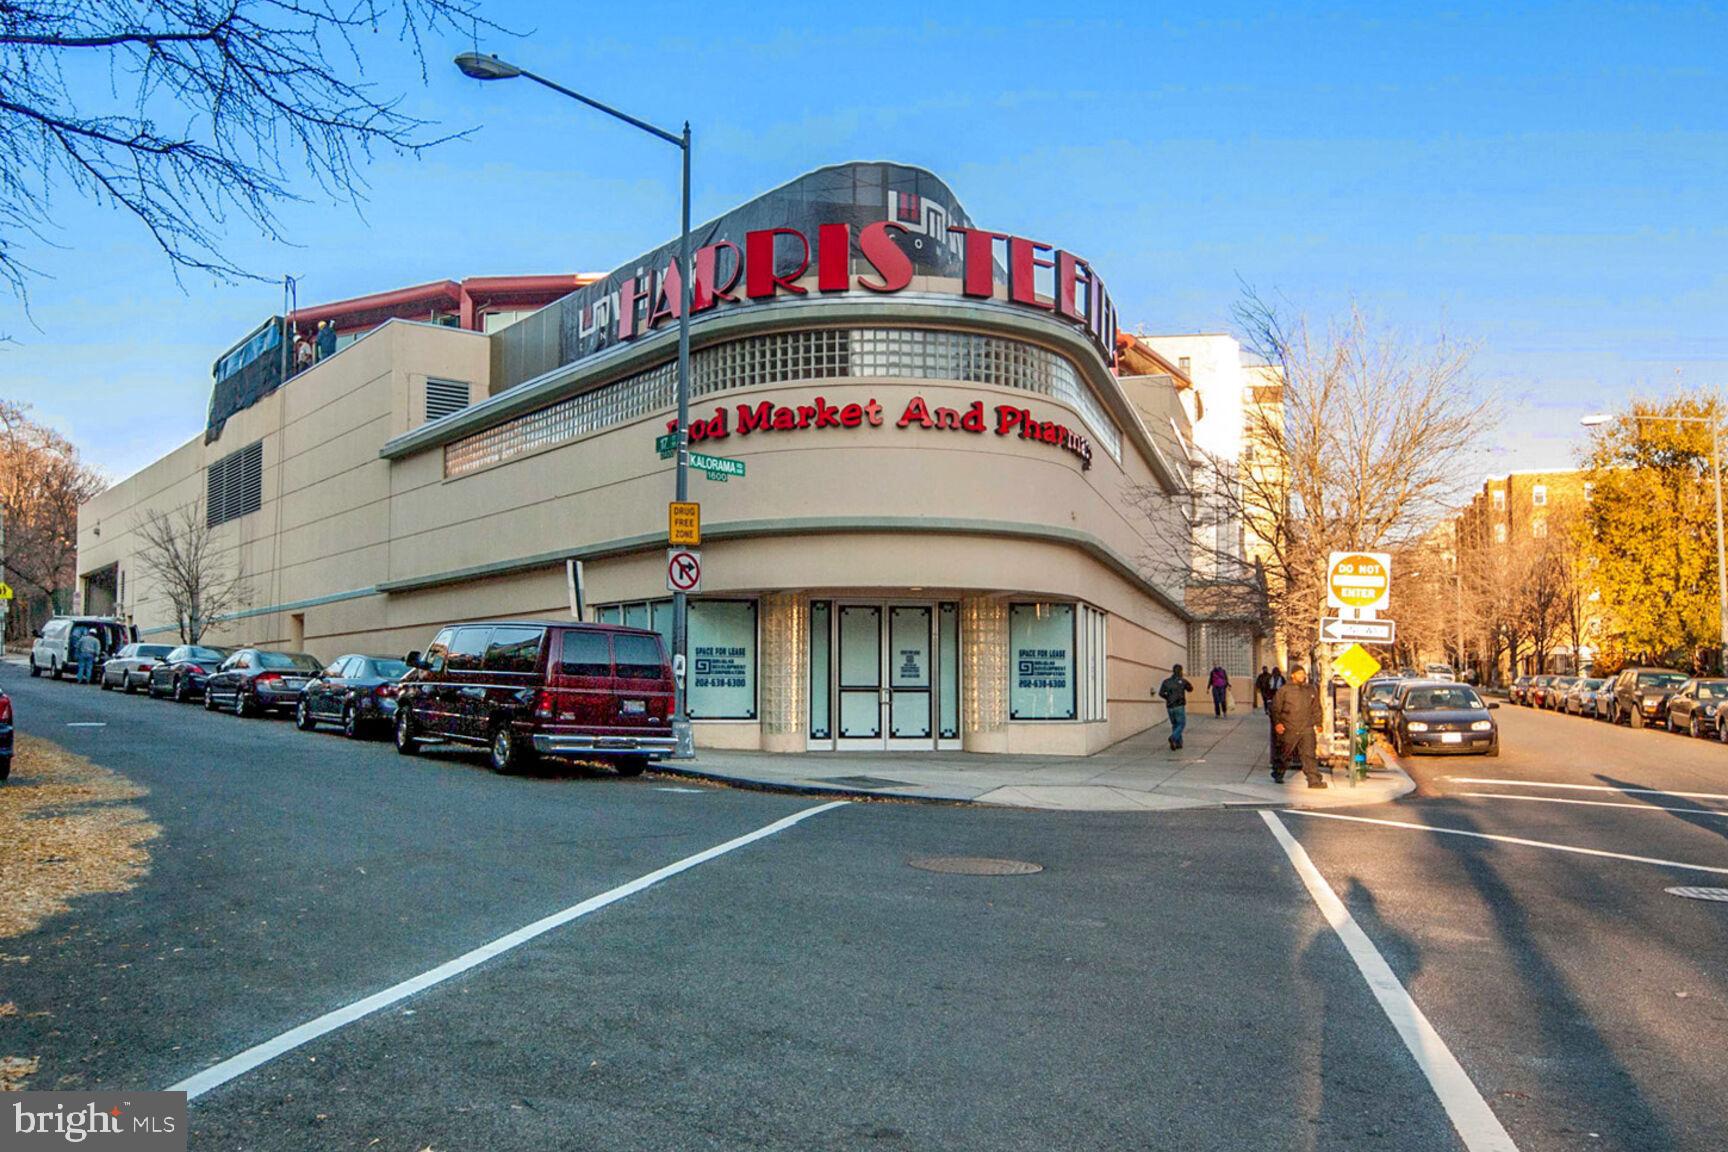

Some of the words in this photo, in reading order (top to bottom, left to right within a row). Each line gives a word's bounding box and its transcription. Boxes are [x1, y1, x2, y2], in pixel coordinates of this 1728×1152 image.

[618, 220, 914, 342] HARRIS
[736, 396, 884, 435] Market
[898, 396, 987, 433] And
[690, 454, 736, 473] KALORAMA
[674, 507, 695, 515] DRUG
[675, 519, 694, 527] FREE
[676, 530, 693, 538] ZONE
[1339, 565, 1353, 573] DO
[1359, 565, 1379, 574] NOT
[728, 648, 745, 656] LEASE
